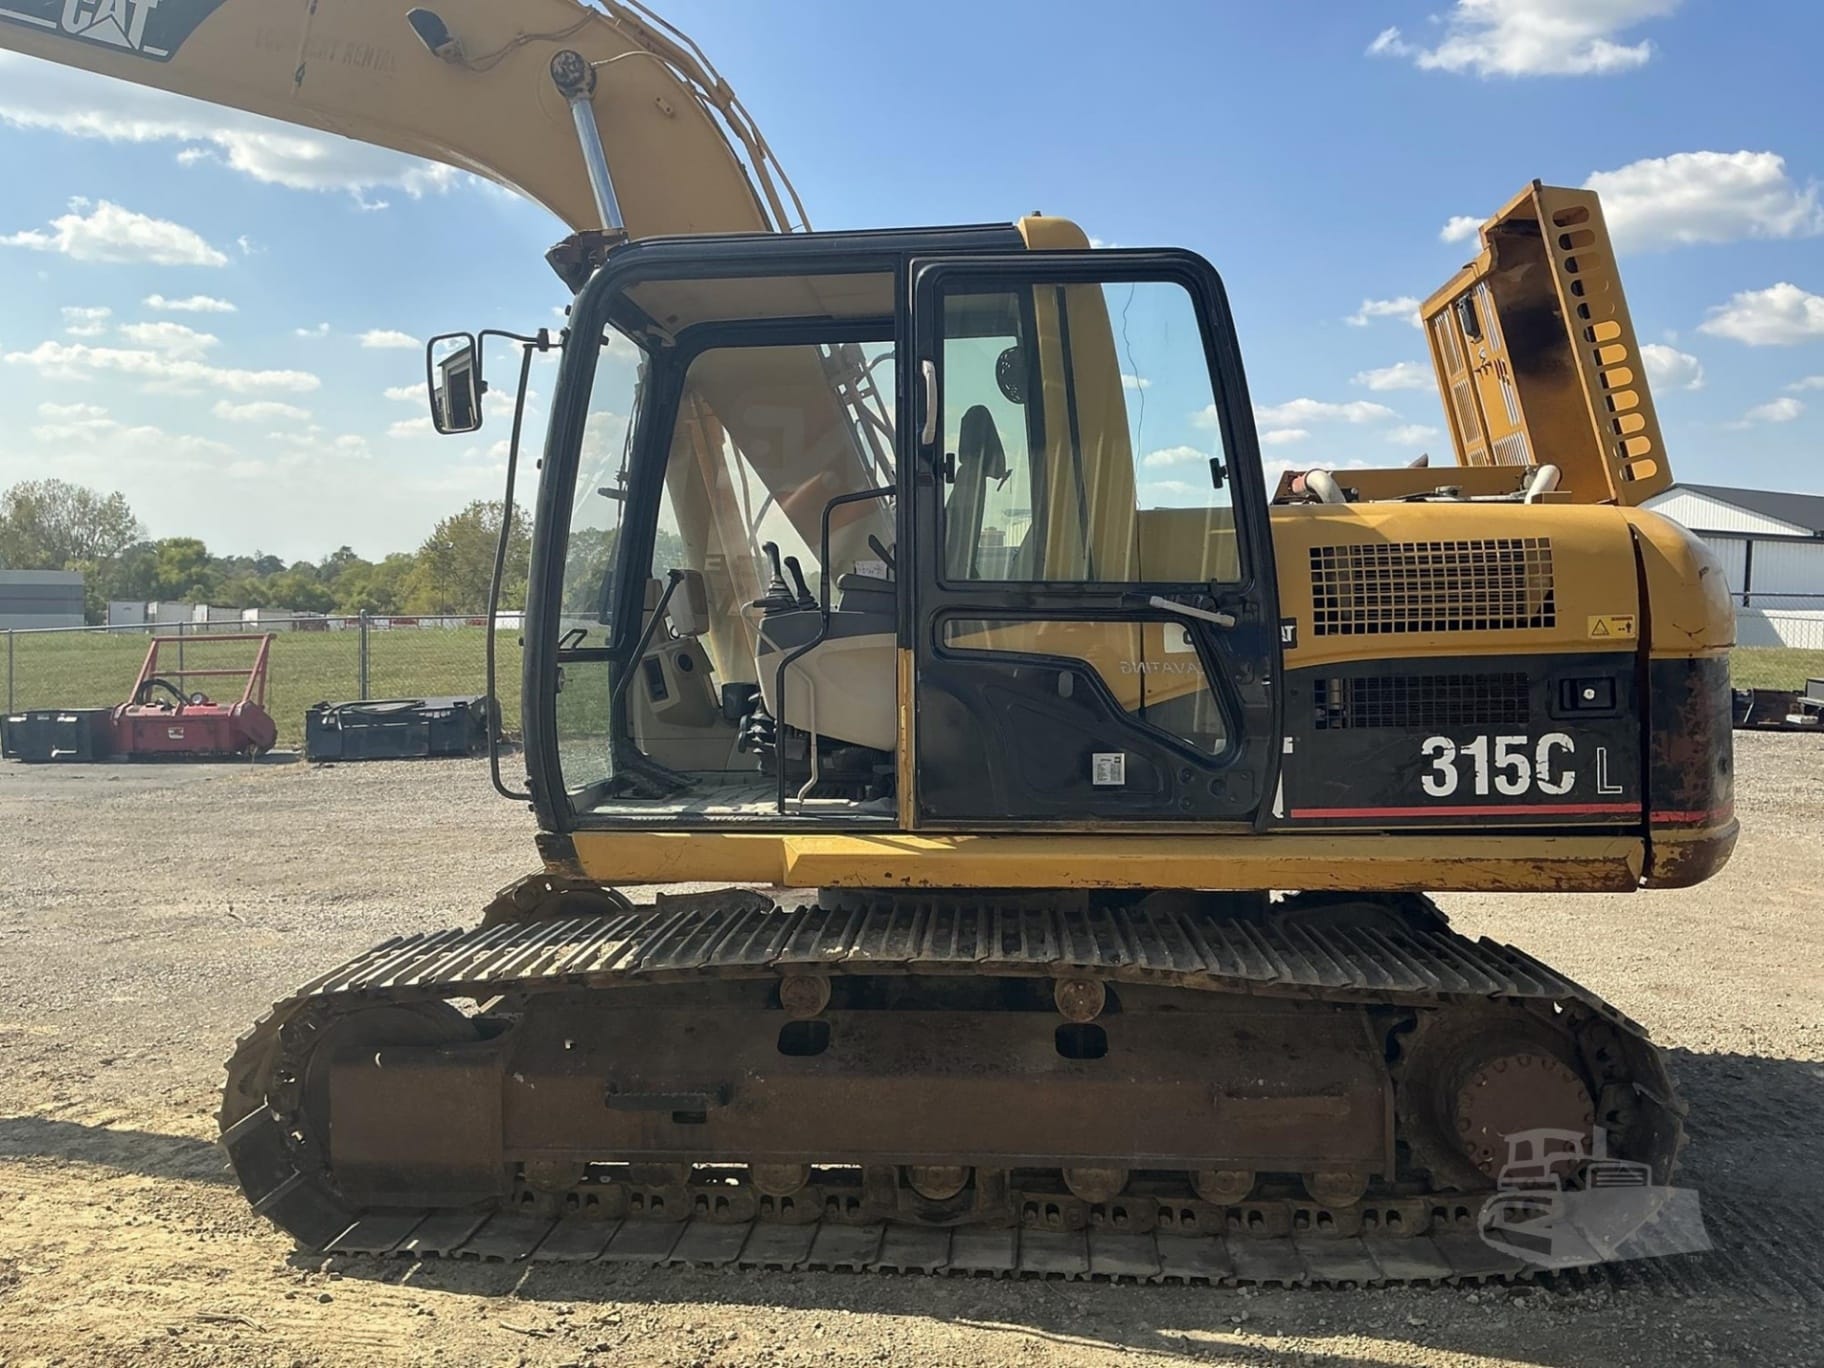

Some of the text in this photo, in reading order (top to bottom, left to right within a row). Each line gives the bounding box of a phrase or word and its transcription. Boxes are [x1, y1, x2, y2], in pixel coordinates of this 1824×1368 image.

[61, 0, 159, 50] CAT
[1280, 625, 1296, 642] AT
[1421, 732, 1623, 797] 315C L
